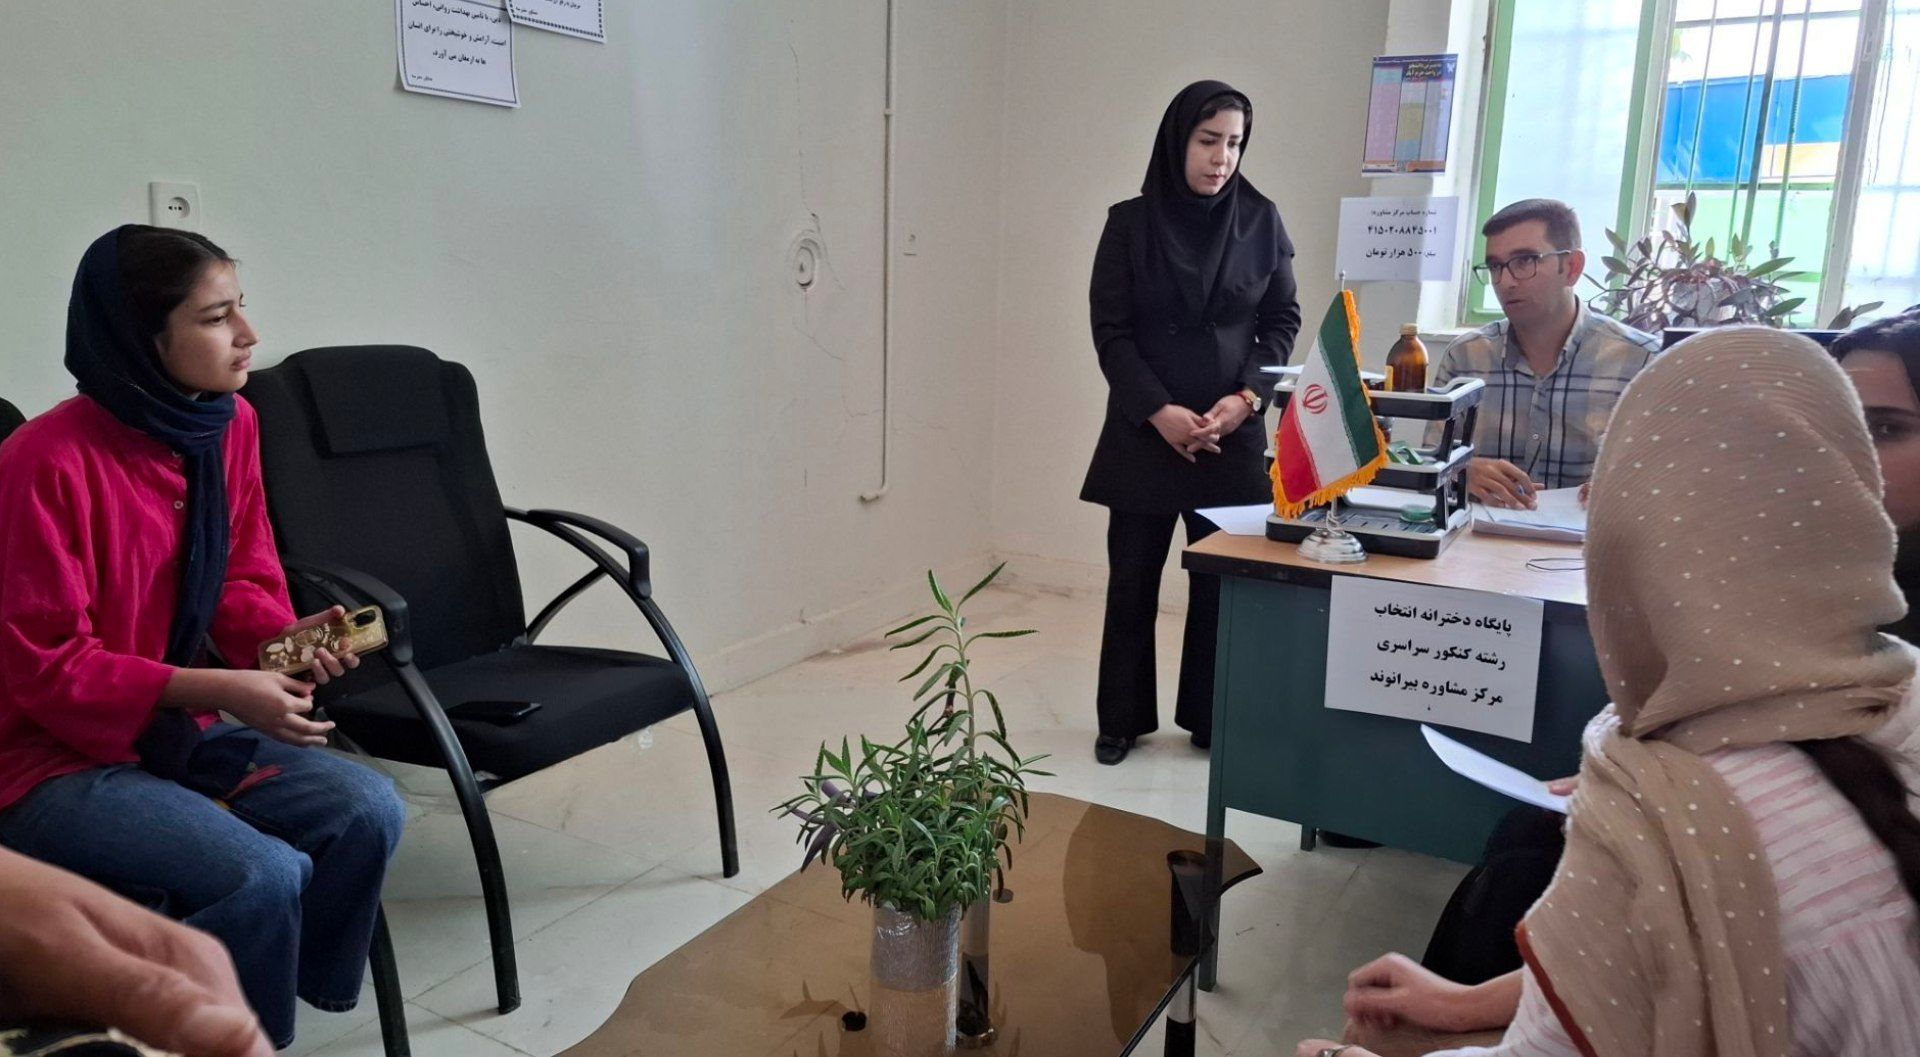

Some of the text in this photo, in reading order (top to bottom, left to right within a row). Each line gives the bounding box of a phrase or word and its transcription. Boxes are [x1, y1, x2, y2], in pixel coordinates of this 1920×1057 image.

[1365, 247, 1387, 259] تومان
[1388, 247, 1406, 259] هزار
[1374, 602, 1513, 637] پایگاه دخترانه انتخاب
[1376, 639, 1506, 671] رشته کنکور سراسری
[1369, 669, 1504, 706] مرکز مشاوره بیرانوند
